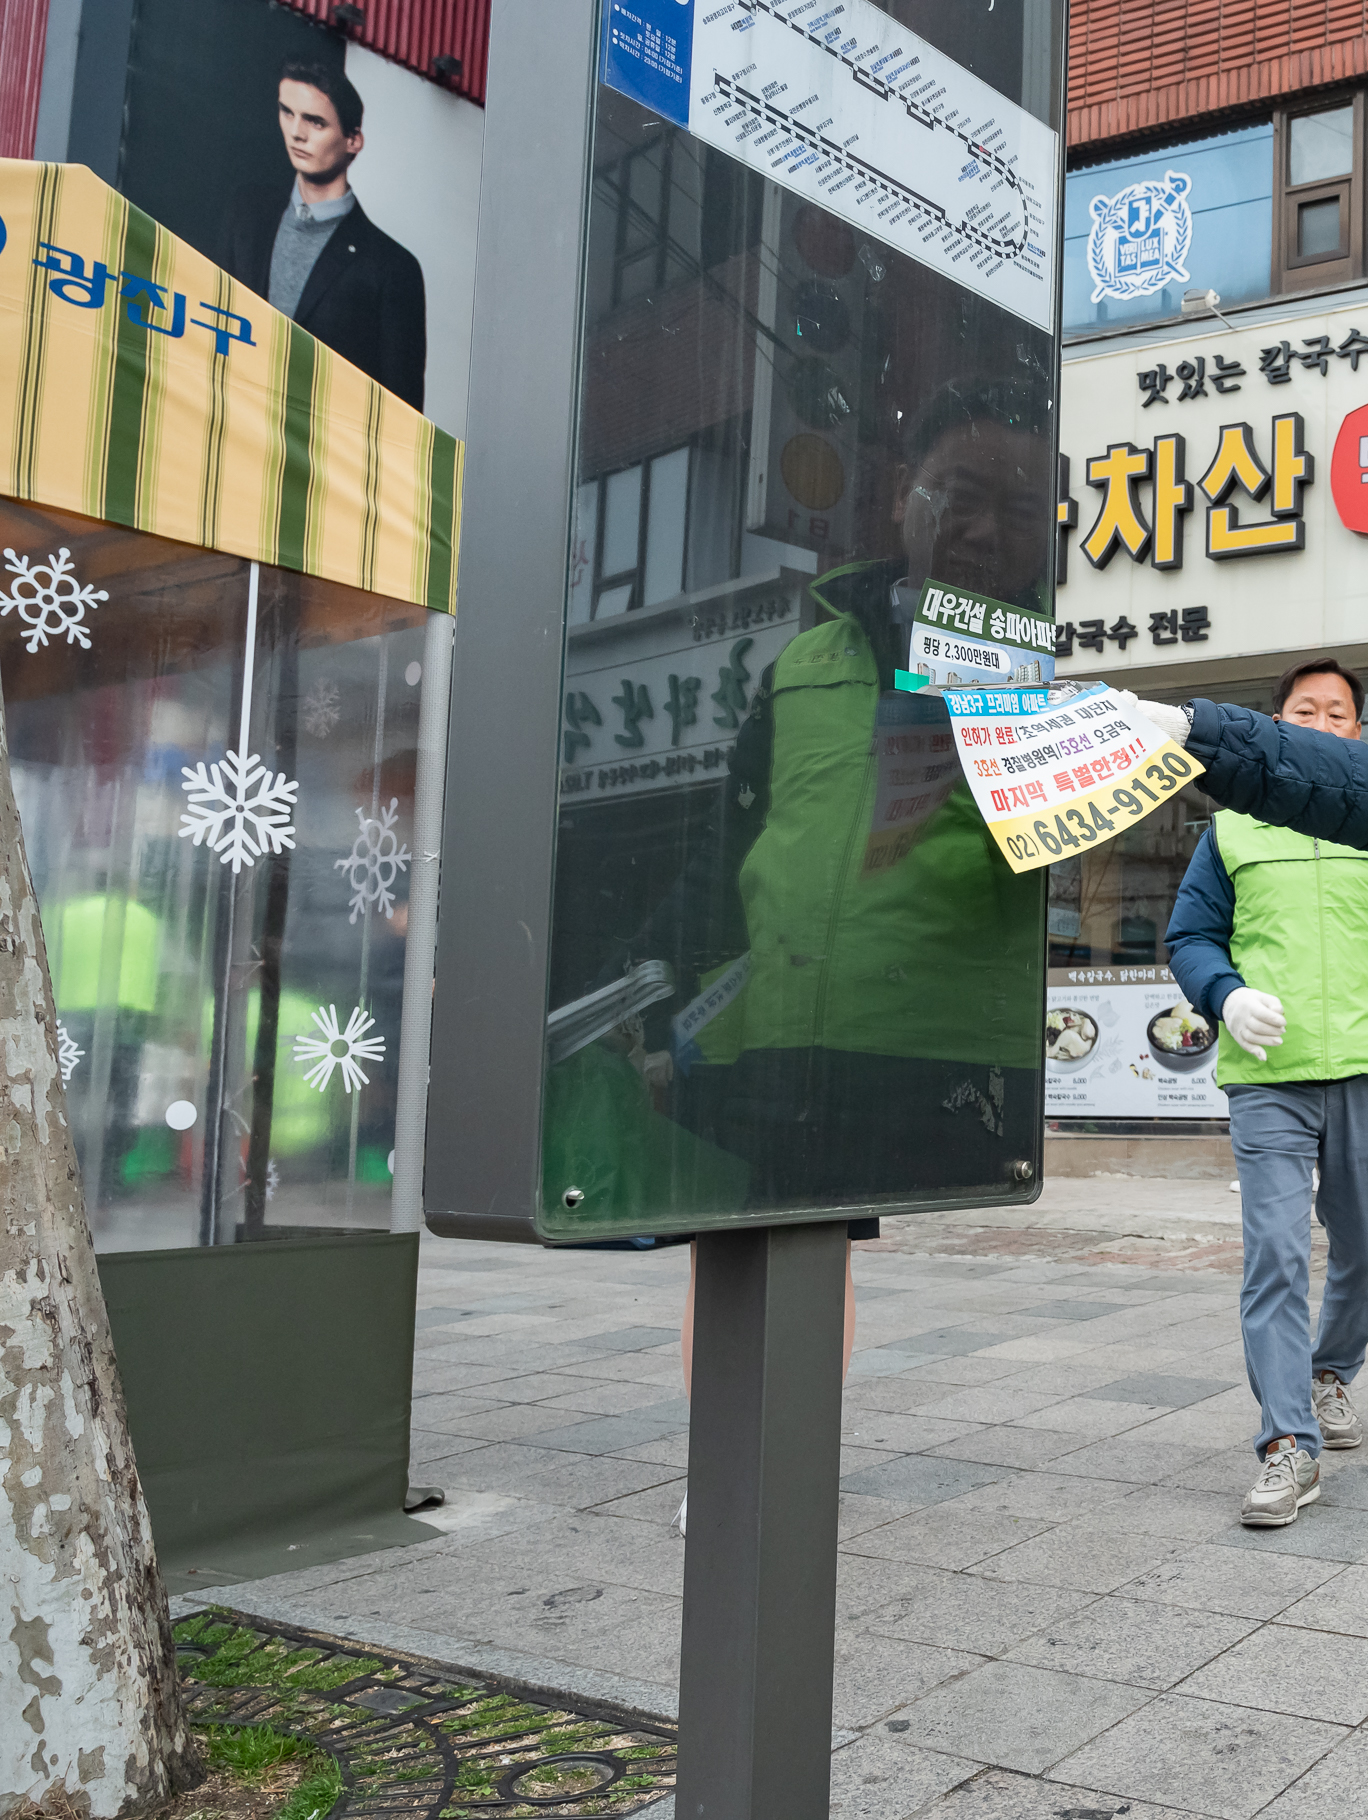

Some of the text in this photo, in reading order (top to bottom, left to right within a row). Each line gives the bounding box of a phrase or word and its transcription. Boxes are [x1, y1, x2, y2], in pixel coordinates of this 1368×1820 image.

[32, 242, 257, 357] 광진구
[1137, 356, 1246, 408] 맛있는
[921, 587, 988, 635] 대우건설
[1148, 605, 1211, 645] 전문
[923, 636, 1001, 670] 평당 2,300만원대
[948, 692, 1050, 715] 강남3구 프리미엄 아파트
[960, 726, 993, 747] 인허가
[1074, 699, 1119, 721] 대단지
[976, 757, 1003, 778] 3호선
[1093, 719, 1131, 745] 오금역
[990, 780, 1048, 813] 마지막
